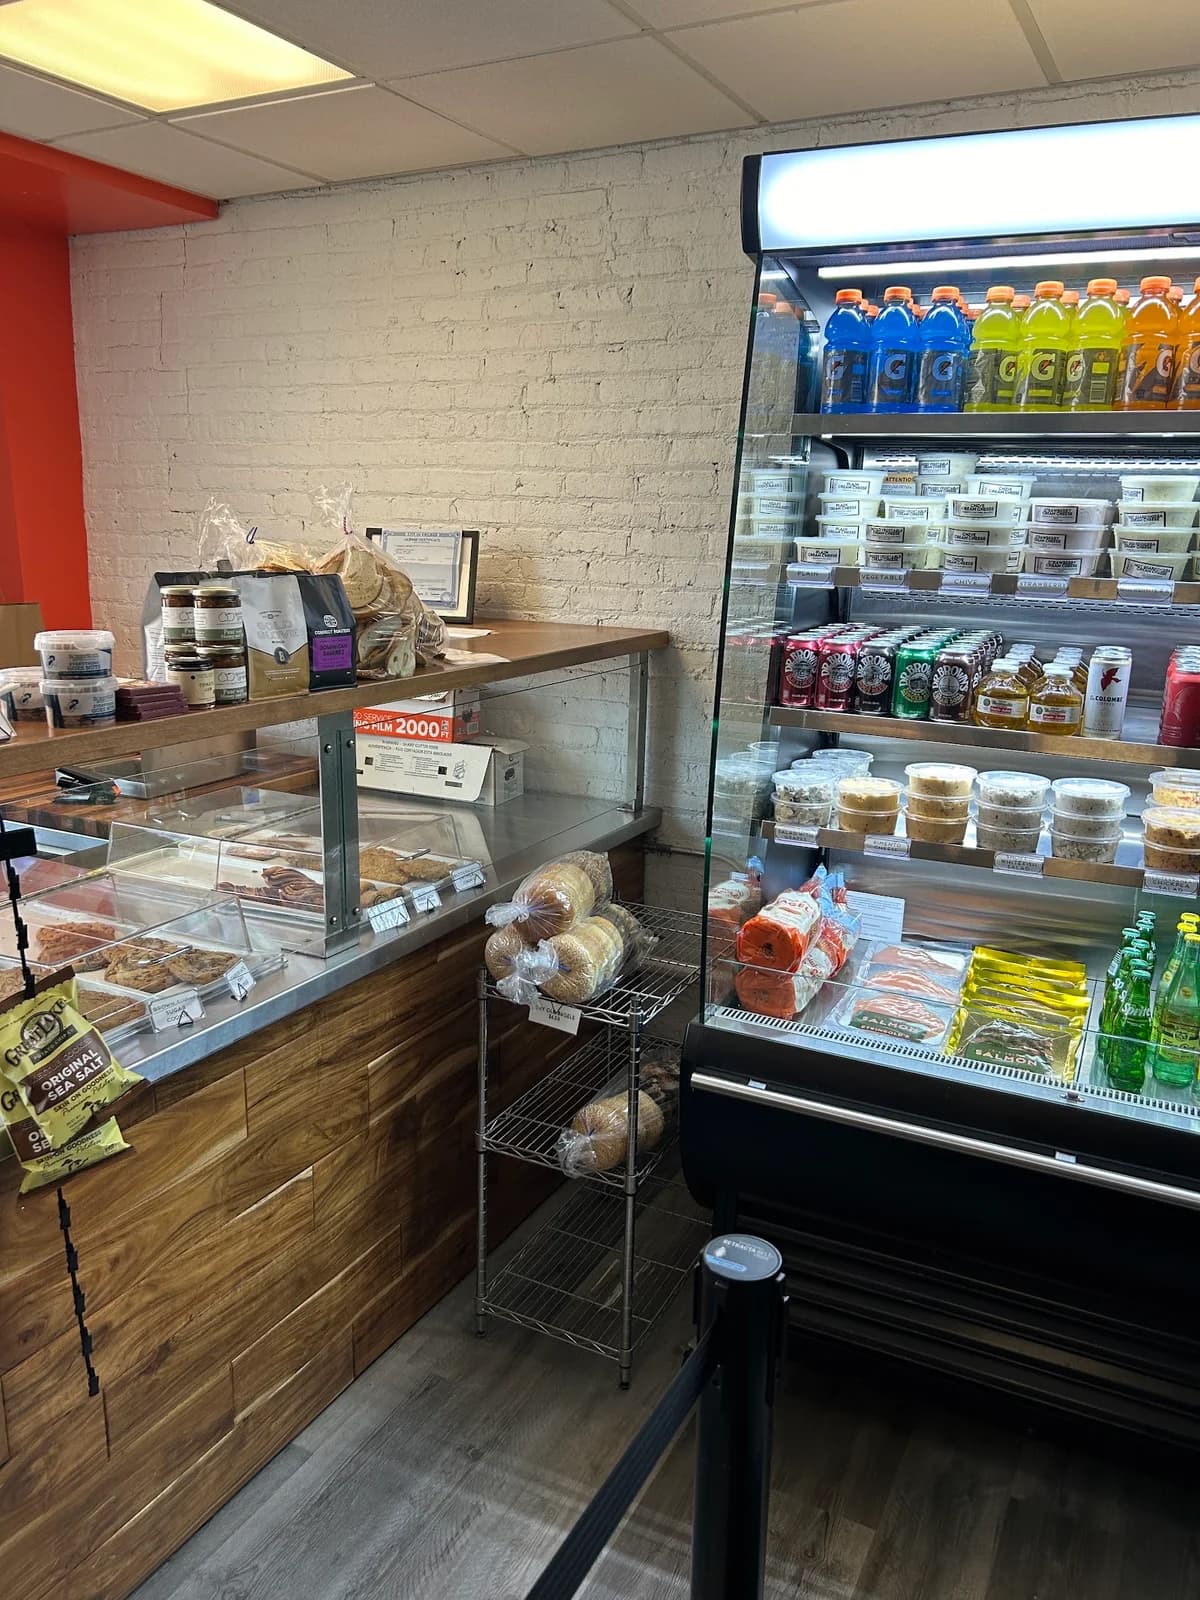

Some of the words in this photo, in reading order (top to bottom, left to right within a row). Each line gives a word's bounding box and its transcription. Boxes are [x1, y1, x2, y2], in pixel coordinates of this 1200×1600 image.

[826, 354, 844, 380] G
[885, 354, 906, 380] G
[932, 354, 953, 381] G
[999, 356, 1016, 382] G
[1031, 353, 1056, 381] G
[1066, 354, 1083, 382] G
[1157, 350, 1174, 377] G
[363, 712, 393, 723] SERVICE
[371, 722, 393, 733] FILM
[395, 717, 440, 738] 2000
[1152, 879, 1190, 889] CHICKPEA
[166, 1005, 187, 1016] SUGAR
[1121, 1002, 1152, 1020] Sprite
[41, 1048, 99, 1091] ORIGINAL
[975, 1049, 1038, 1067] SALMON
[48, 1080, 75, 1102] SEA
[75, 1055, 104, 1082] SALT
[53, 1100, 71, 1113] SKIN
[71, 1091, 82, 1102] ON
[82, 1067, 115, 1094] GOODNESS
[32, 1139, 51, 1154] SE
[66, 1131, 102, 1152] GOODNESS
